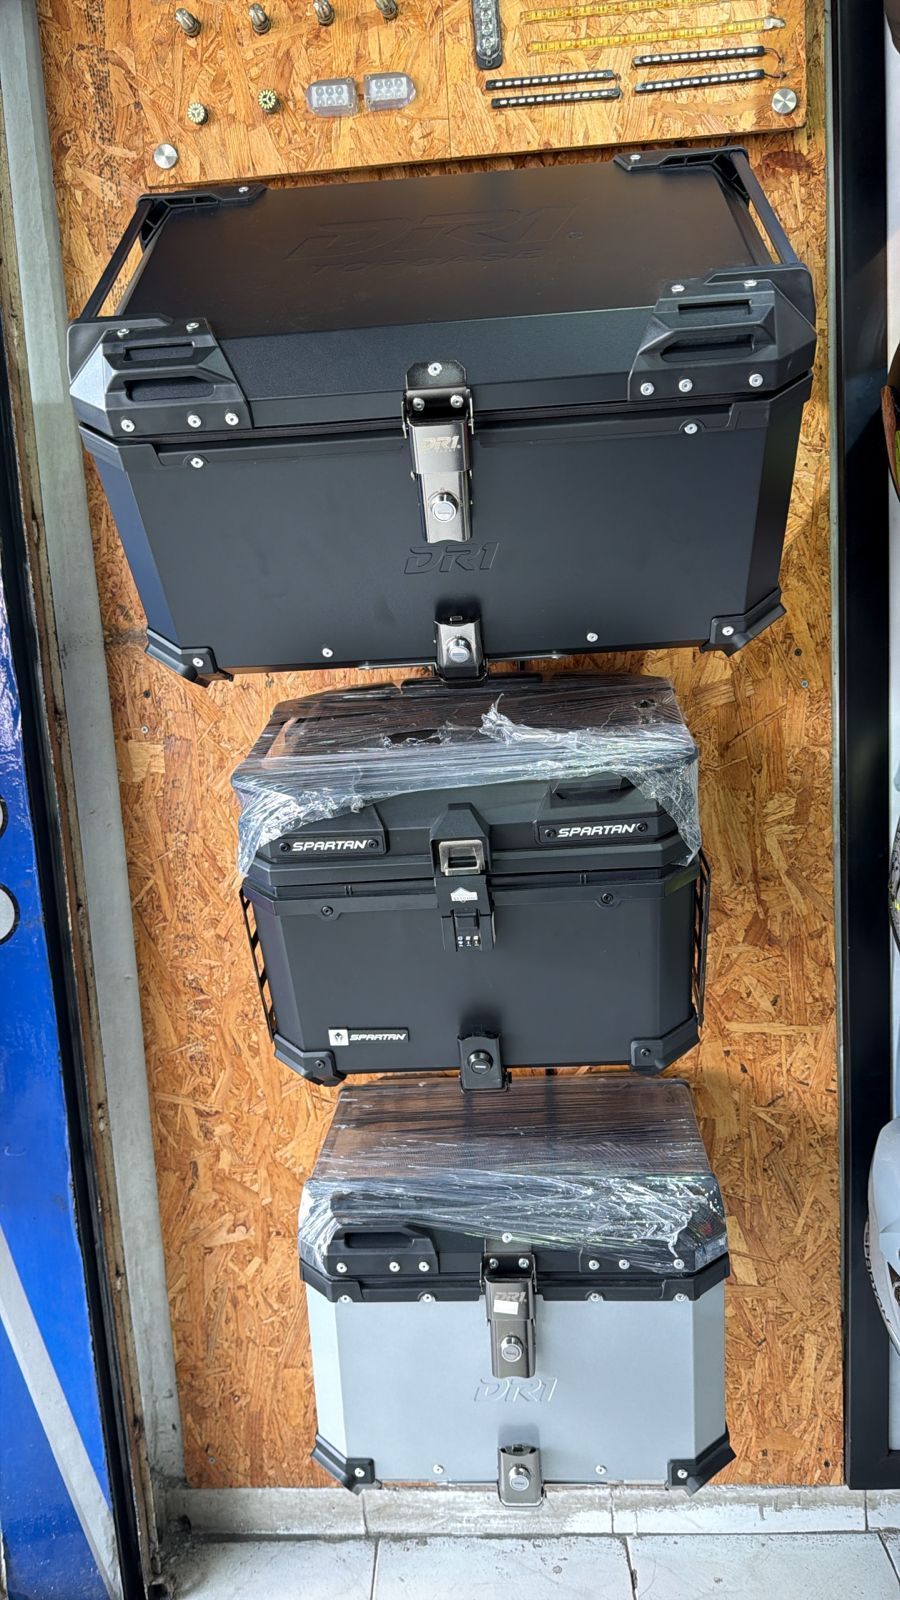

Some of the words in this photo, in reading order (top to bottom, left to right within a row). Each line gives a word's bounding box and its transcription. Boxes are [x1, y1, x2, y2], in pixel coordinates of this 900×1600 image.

[404, 541, 500, 575] DR1
[556, 823, 637, 838] SPARTAN
[291, 839, 367, 852] SPARTAN
[349, 1033, 407, 1041] SPARTAN
[473, 1377, 558, 1403] DR1
